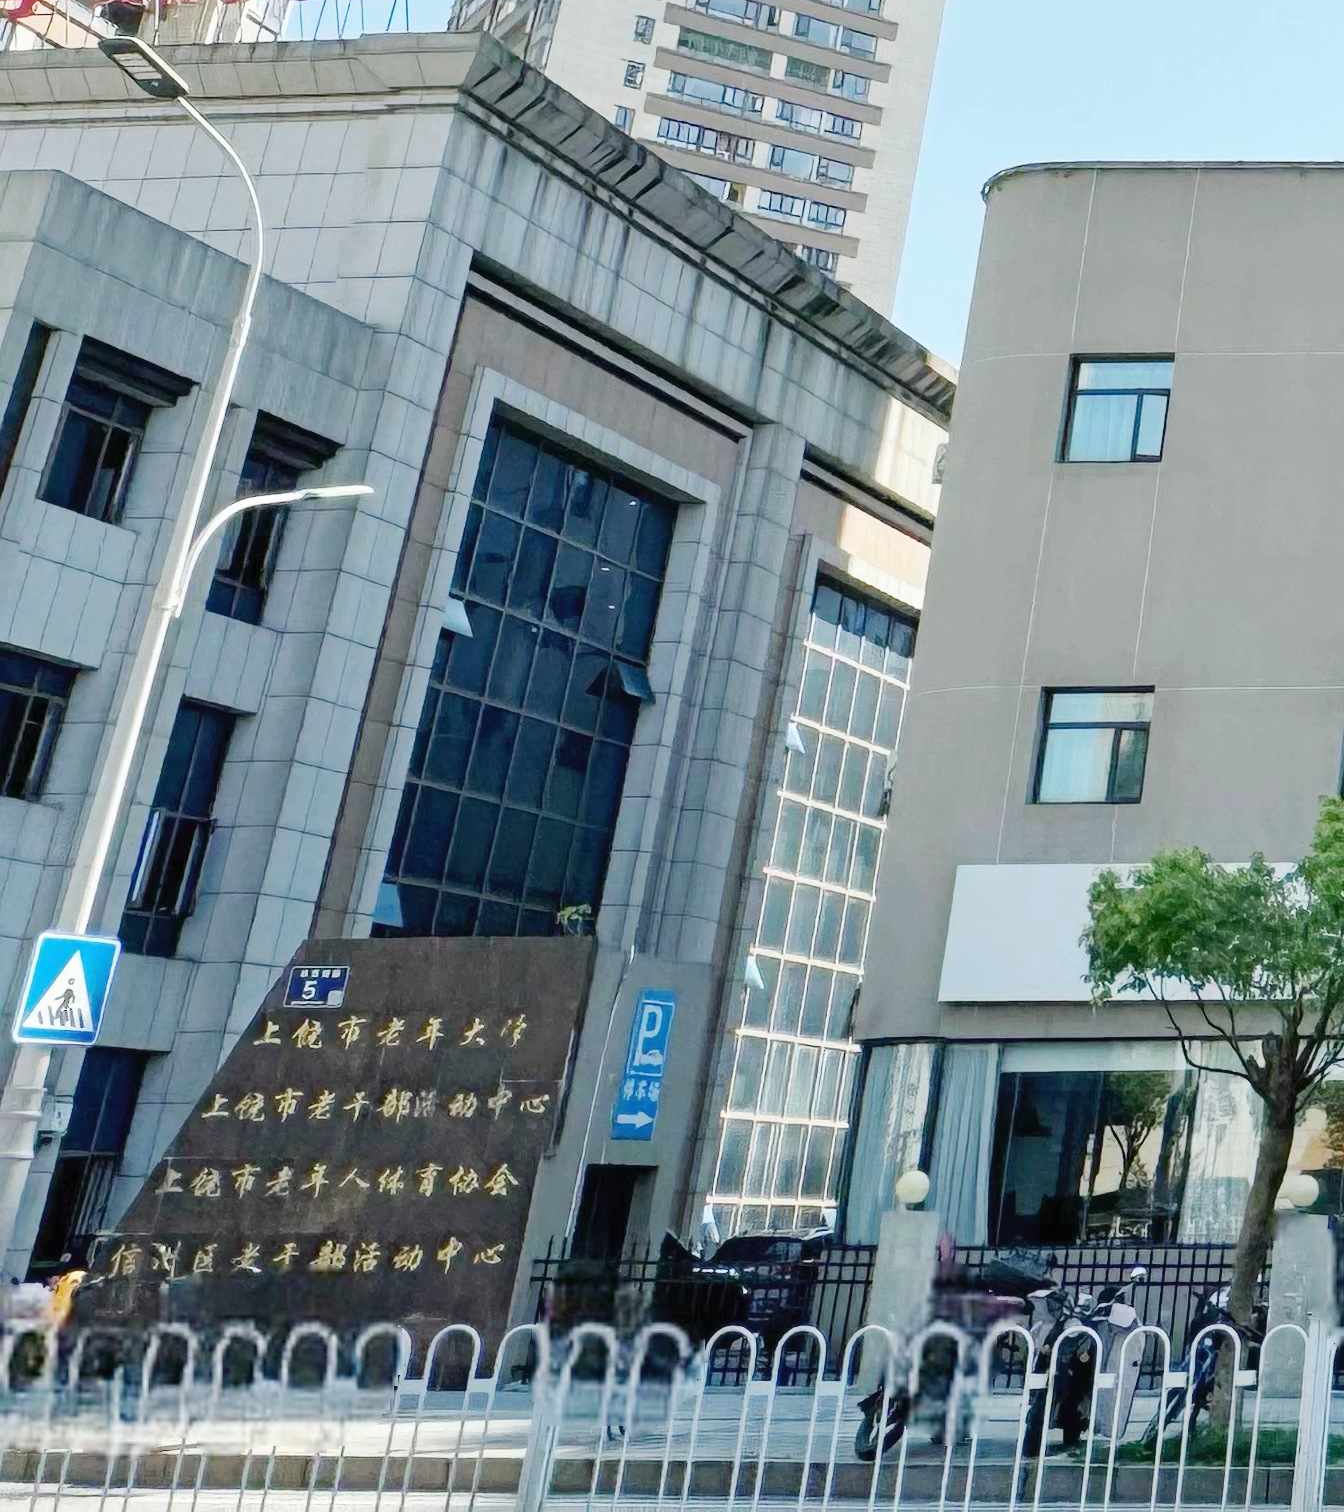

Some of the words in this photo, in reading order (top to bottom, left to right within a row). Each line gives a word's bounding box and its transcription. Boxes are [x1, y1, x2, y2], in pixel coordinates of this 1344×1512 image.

[302, 980, 317, 1000] 5
[253, 1014, 528, 1051] 上饶市老年大学
[633, 1004, 663, 1067] P
[201, 1084, 551, 1122] 上饶市老干部活动中心
[155, 1163, 520, 1199] 上饶市老年人体育协会
